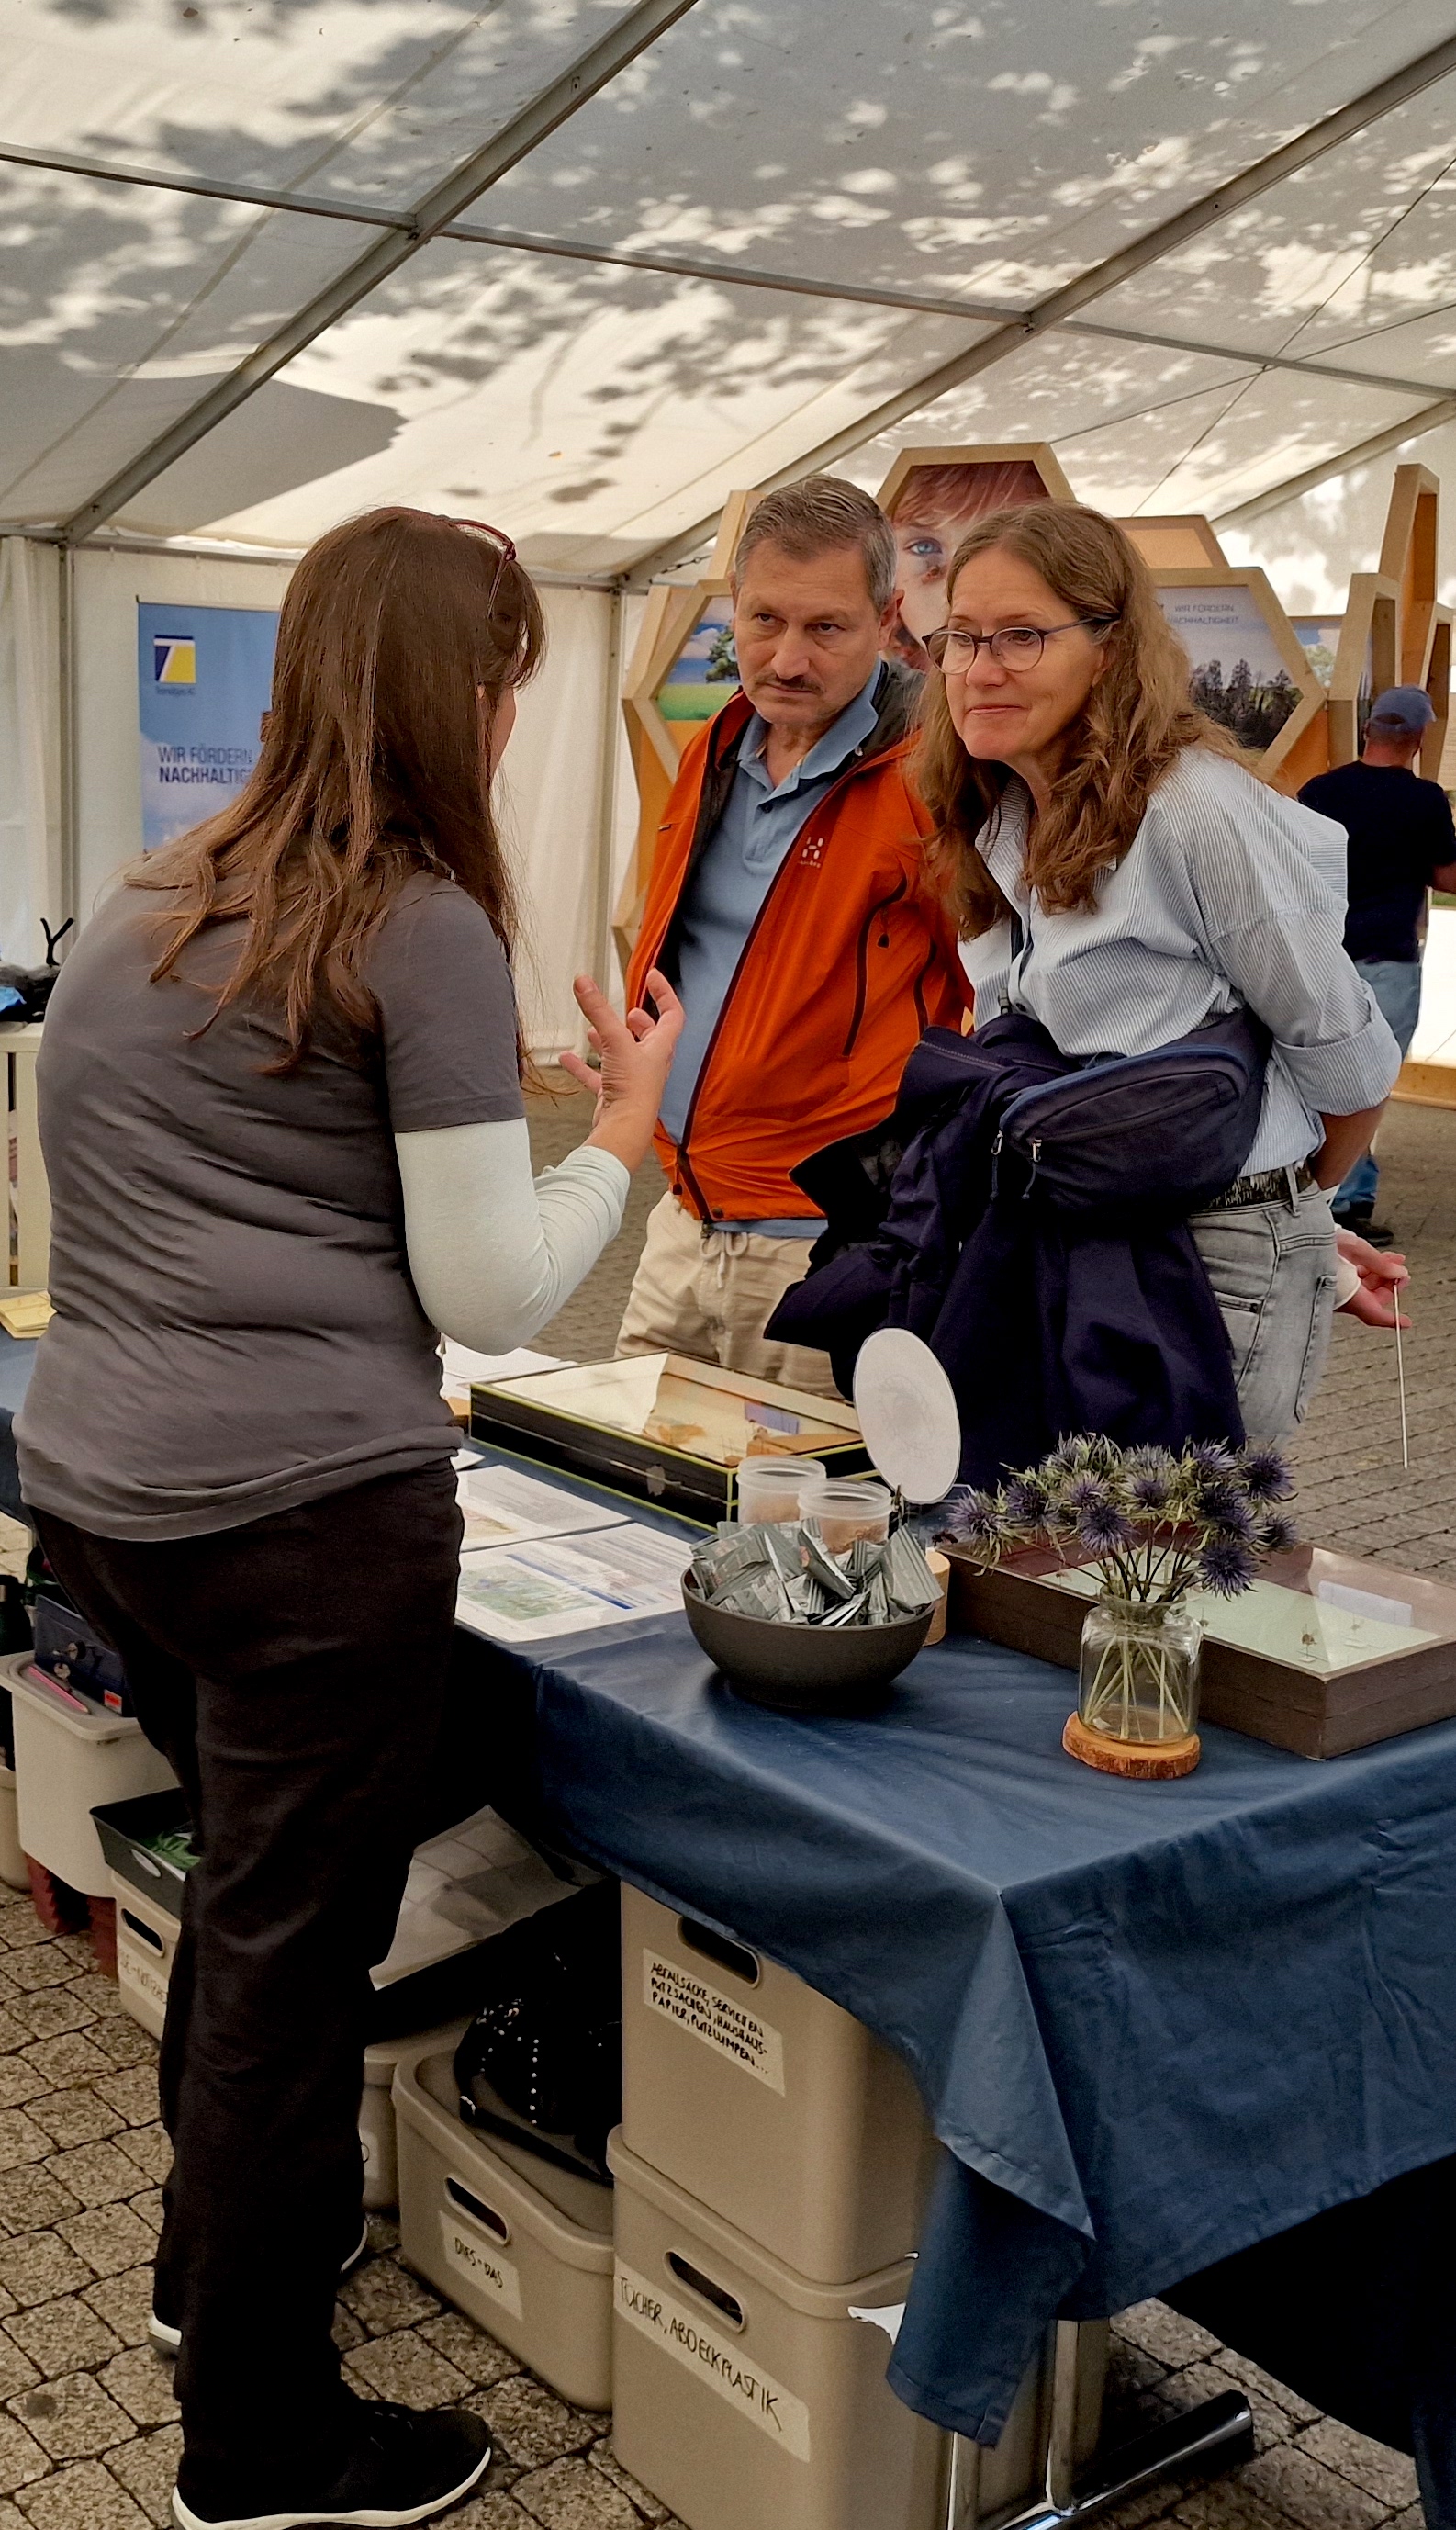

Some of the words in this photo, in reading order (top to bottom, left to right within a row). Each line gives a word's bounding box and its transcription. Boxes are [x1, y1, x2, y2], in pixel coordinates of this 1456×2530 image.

[157, 746, 186, 763] WIR
[189, 742, 253, 765] FÖRDERN
[159, 766, 252, 785] NACHHALTIG
[669, 2316, 783, 2434] ABDECKPLASTIK
